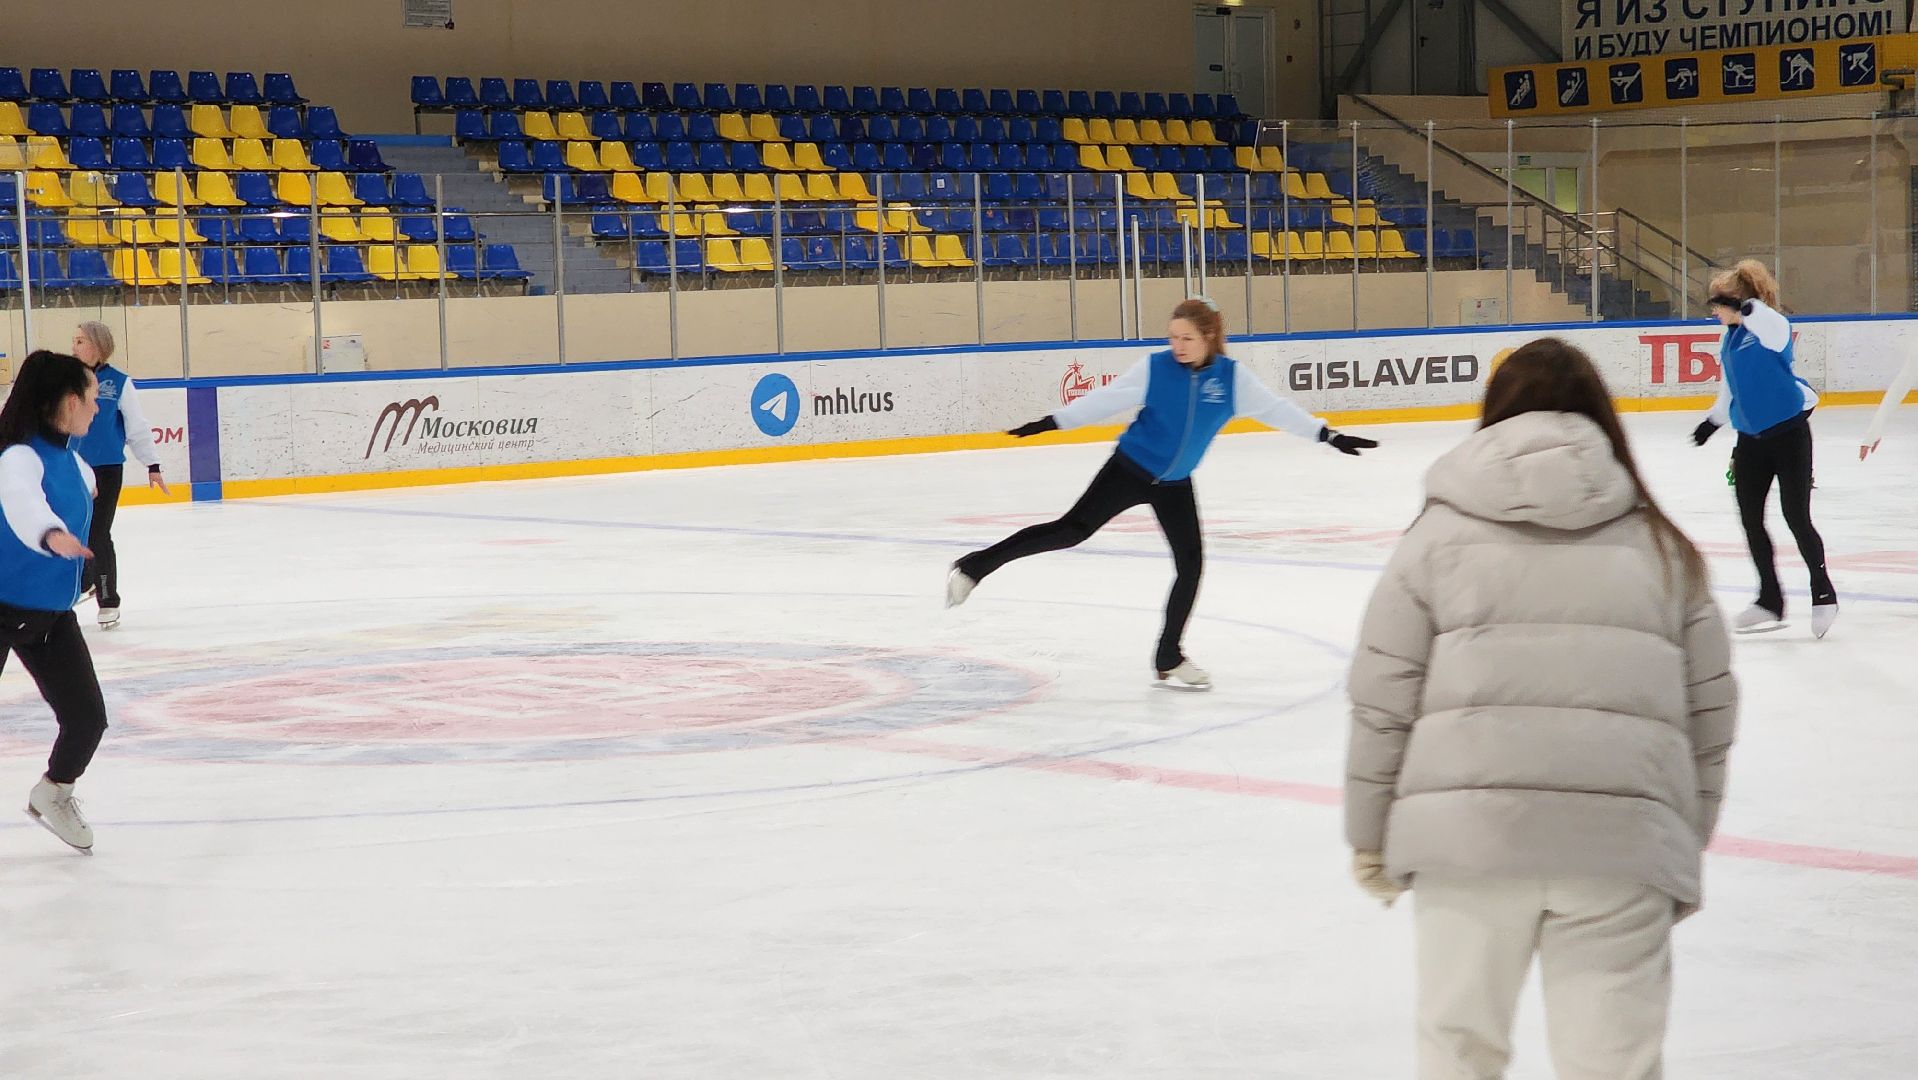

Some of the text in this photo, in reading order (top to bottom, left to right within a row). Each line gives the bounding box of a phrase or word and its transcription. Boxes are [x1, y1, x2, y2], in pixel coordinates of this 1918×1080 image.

[1575, 0, 1601, 29] Я
[1616, 0, 1668, 26] ИЗ
[1574, 36, 1591, 60] И
[1599, 29, 1670, 58] БУДУ
[1679, 10, 1892, 51] ЧЕМПИОНОМ!
[1289, 355, 1479, 391] GISLAVED
[814, 387, 894, 416] mhlrus
[419, 416, 538, 440] Московия
[416, 438, 535, 455] Медицинский центр
